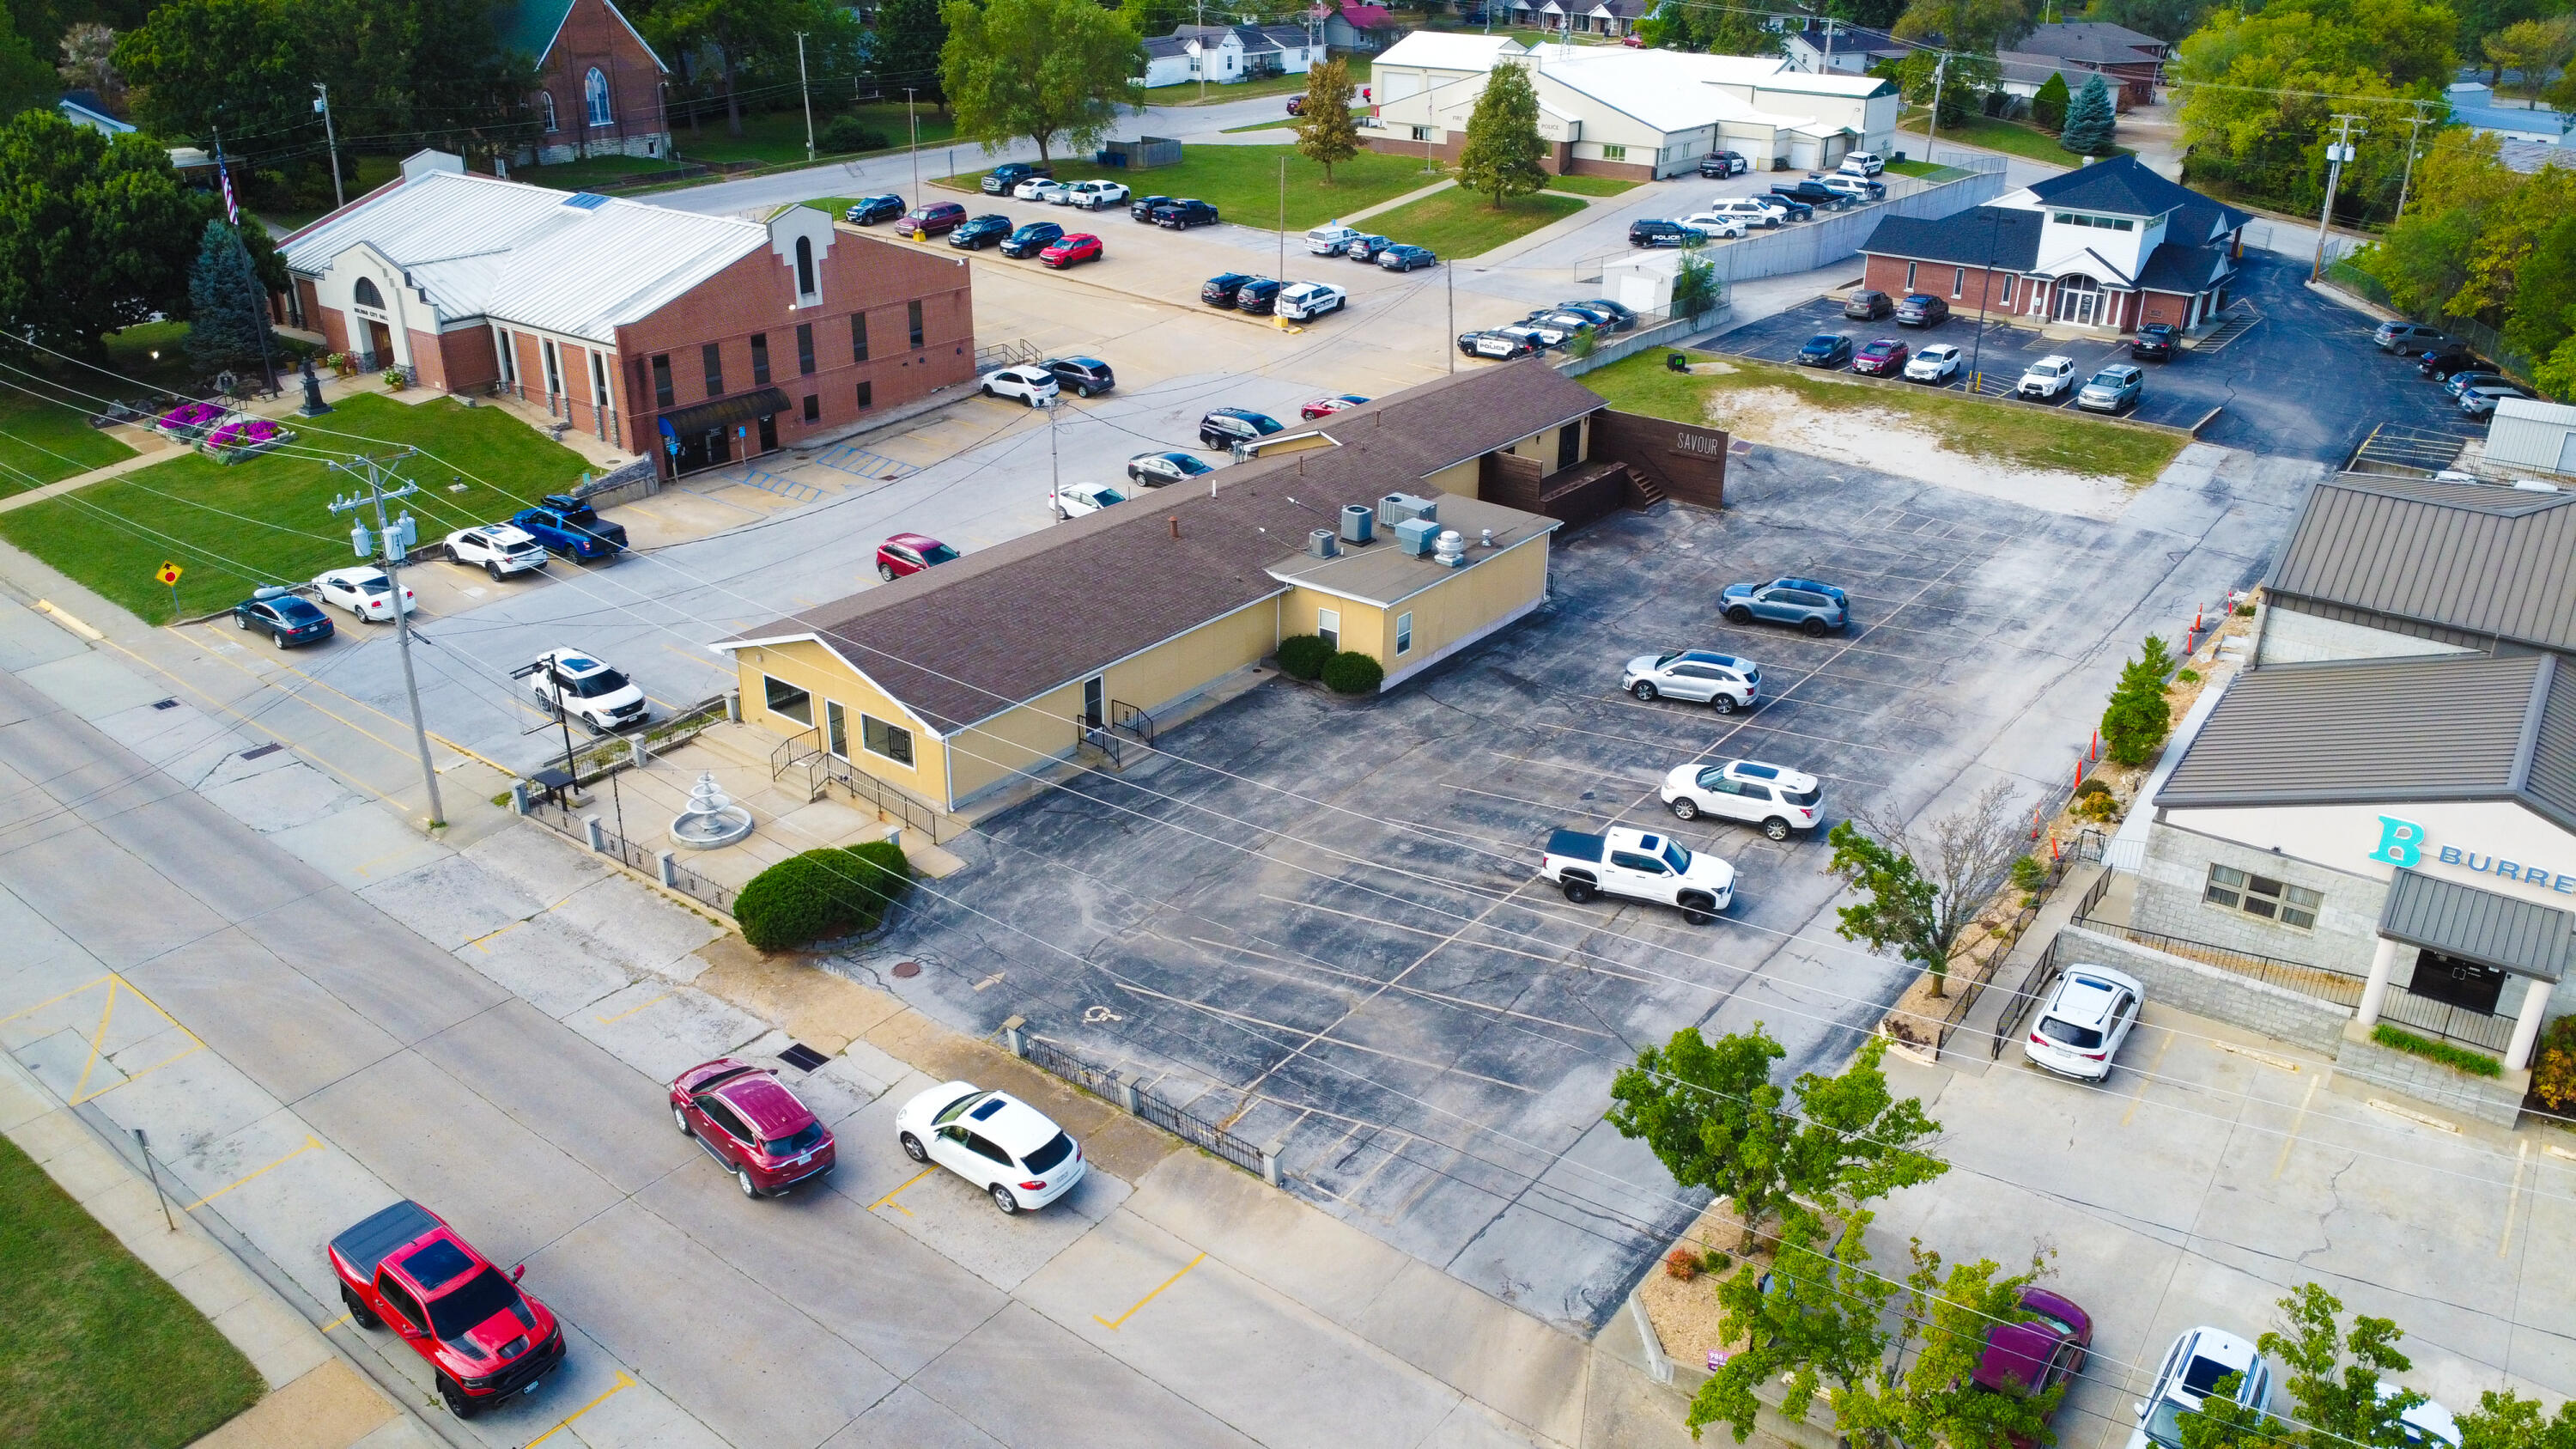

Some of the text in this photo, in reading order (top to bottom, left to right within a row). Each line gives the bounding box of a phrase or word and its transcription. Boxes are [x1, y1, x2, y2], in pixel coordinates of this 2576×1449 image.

[1479, 343, 1506, 351] POLICE
[1677, 432, 1718, 456] SAVOUR
[2368, 813, 2425, 869] B
[2439, 843, 2576, 896] BURRE
